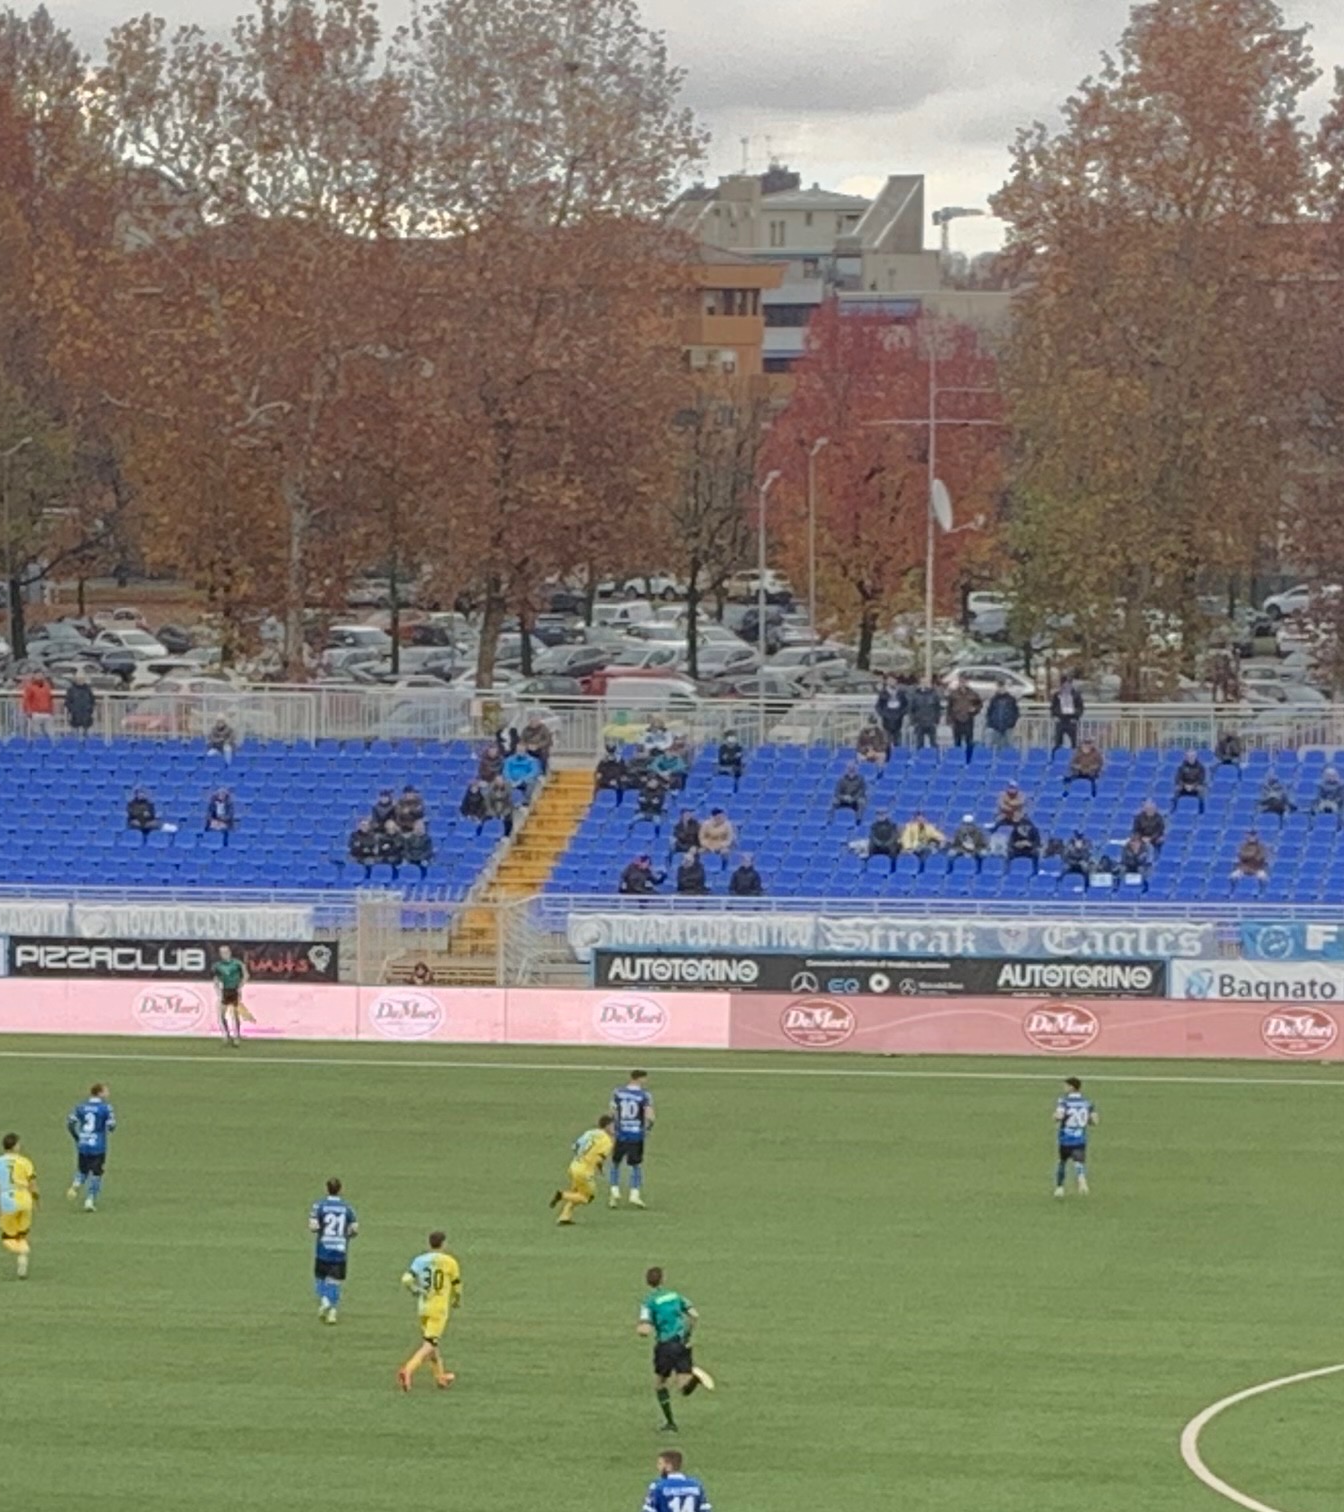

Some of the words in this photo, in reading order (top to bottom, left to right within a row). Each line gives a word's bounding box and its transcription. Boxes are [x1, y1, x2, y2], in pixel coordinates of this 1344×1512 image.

[115, 908, 187, 936] NOVARA
[192, 909, 241, 937] CLUB
[685, 918, 734, 946] CLUB
[820, 917, 977, 954] Streak
[1042, 923, 1204, 958] Eagles
[14, 944, 206, 972] PIZZACLUB
[608, 957, 759, 982] AUTOTORINO
[998, 963, 1153, 989] AUTOTORINO
[1218, 972, 1339, 1001] Bagnato
[619, 1099, 639, 1119] 10
[1065, 1105, 1089, 1128] 20
[323, 1213, 347, 1237] 21
[422, 1267, 445, 1291] 30
